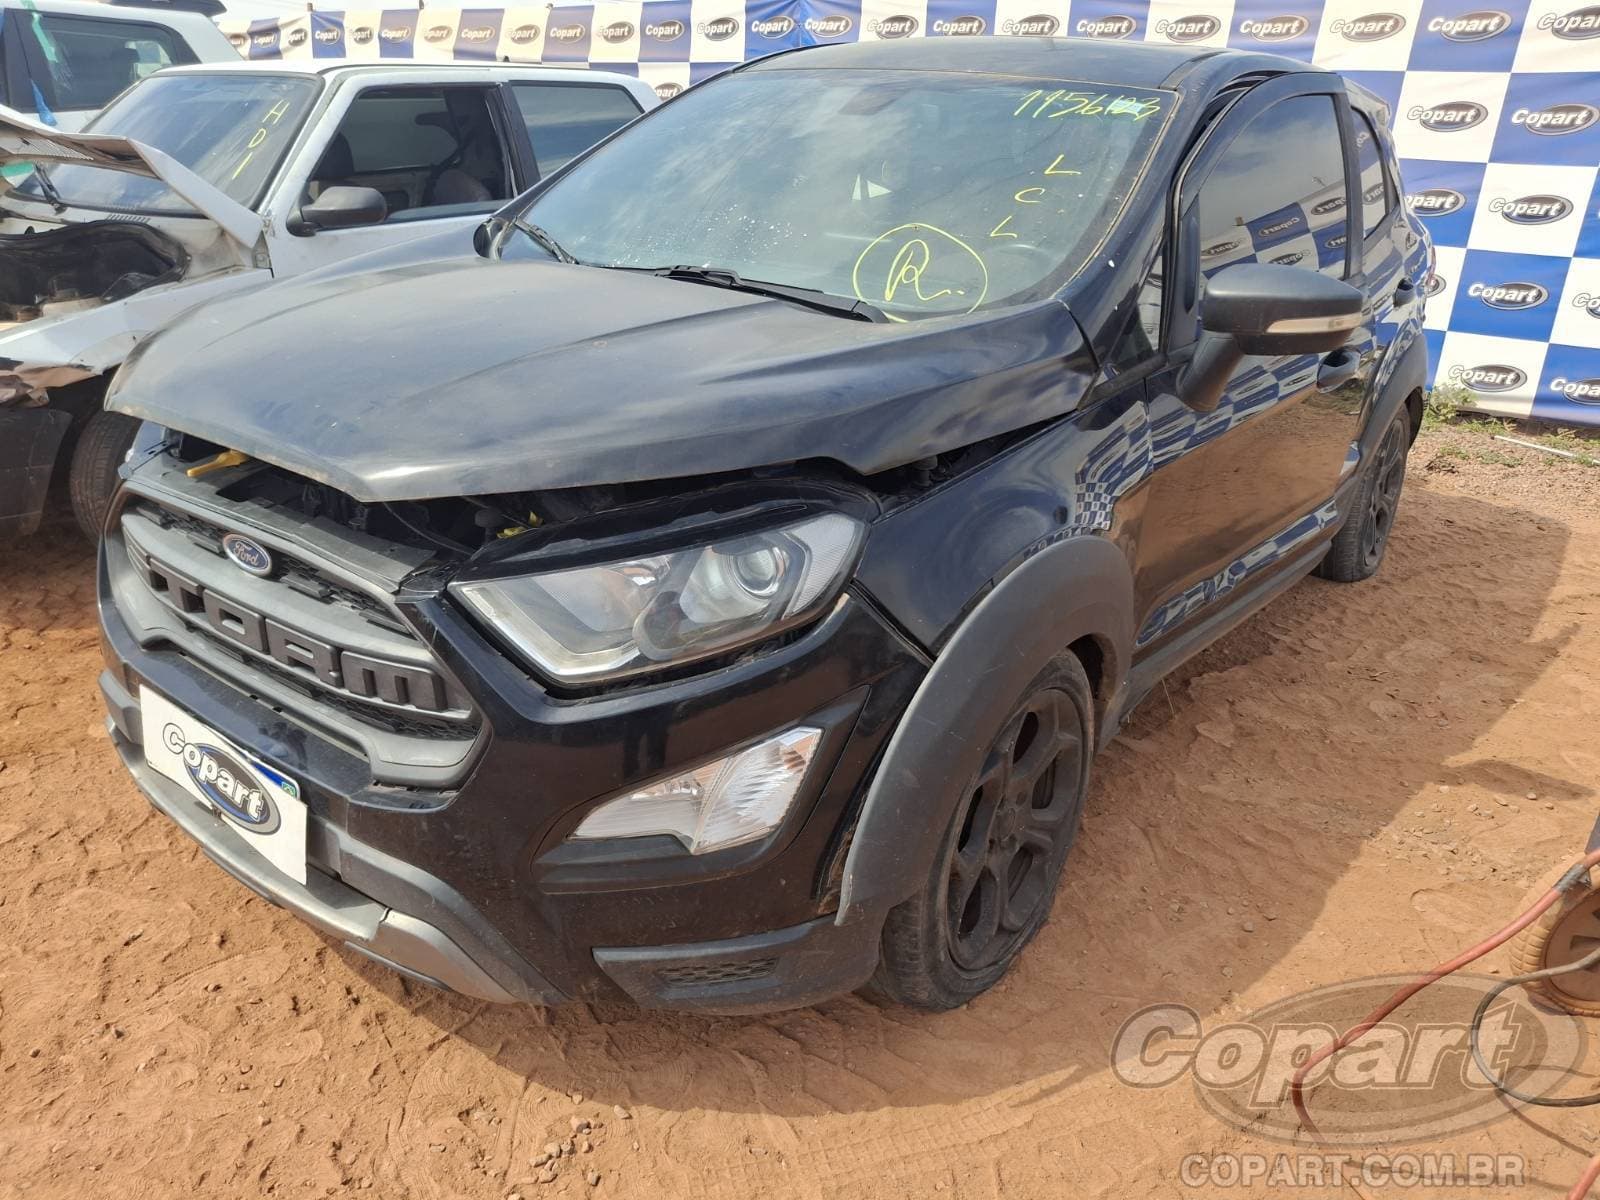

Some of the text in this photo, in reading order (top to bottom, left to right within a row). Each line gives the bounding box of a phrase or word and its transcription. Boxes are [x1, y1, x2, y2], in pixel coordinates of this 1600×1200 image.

[697, 20, 735, 37] Copart
[751, 17, 789, 34] Copart
[804, 17, 846, 33] Copart
[867, 17, 912, 34] Copart
[933, 18, 980, 35] Copart
[1002, 18, 1051, 34] Copart
[1076, 18, 1129, 36] Copart
[1155, 19, 1212, 37] Copart
[1239, 19, 1301, 37] Copart
[1330, 18, 1396, 38] Copart
[1427, 15, 1500, 36] Copart
[1536, 11, 1600, 32] Copa
[461, 27, 492, 39] Copart
[550, 26, 581, 40] Copart
[645, 23, 682, 39] Copart
[655, 86, 677, 98] part
[1407, 104, 1478, 127] Copart
[1511, 108, 1589, 131] Copart
[1489, 197, 1562, 218] Copart
[1468, 282, 1539, 304] Copart
[1449, 364, 1517, 386] Copart
[1550, 377, 1600, 397] Copa
[234, 541, 260, 566] Ford
[163, 722, 264, 822] Copart
